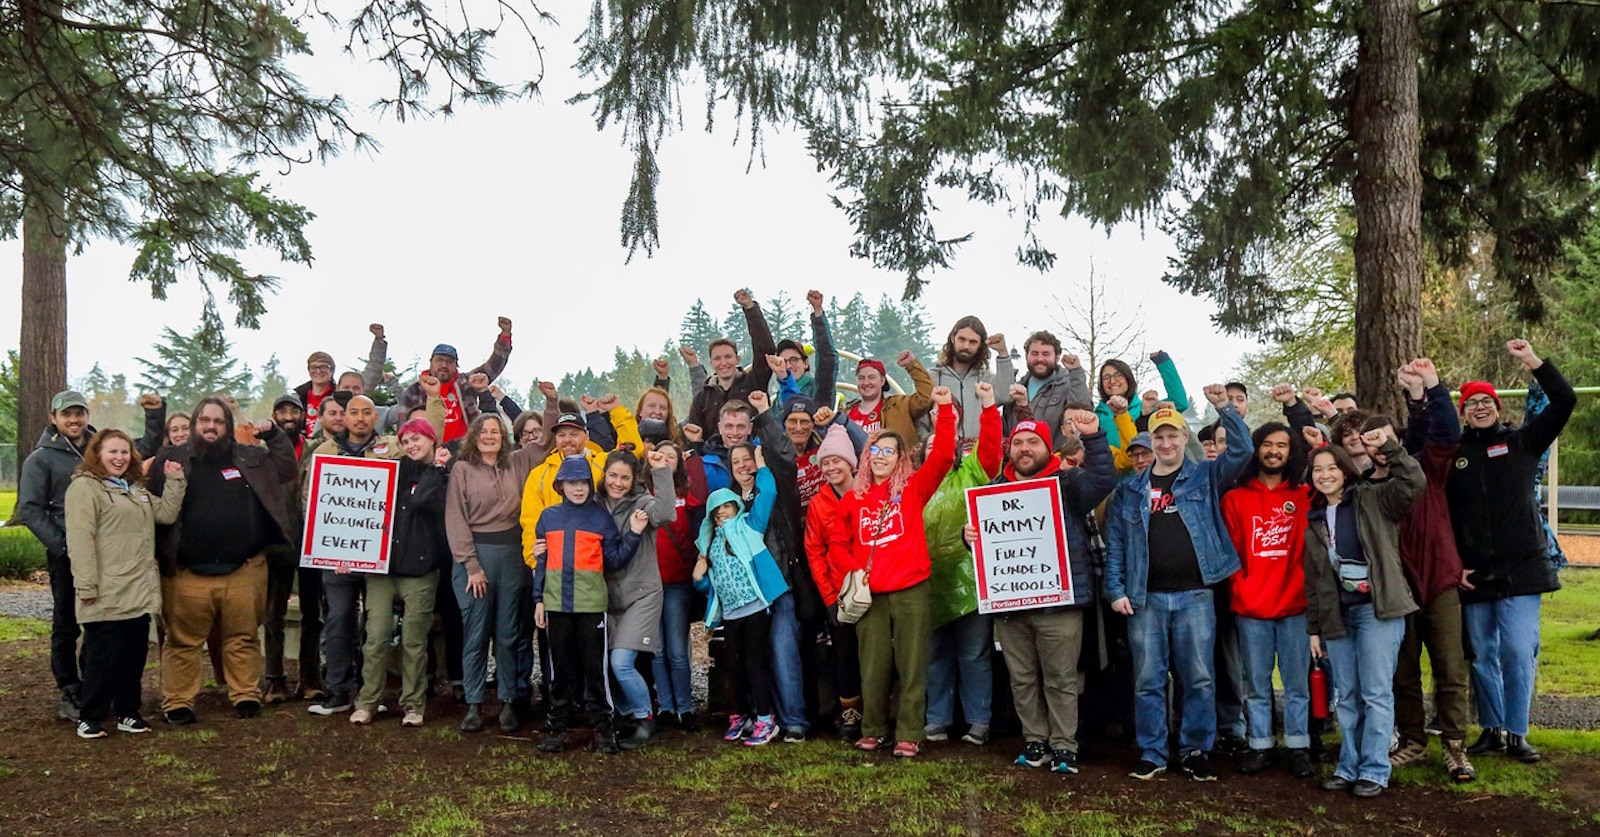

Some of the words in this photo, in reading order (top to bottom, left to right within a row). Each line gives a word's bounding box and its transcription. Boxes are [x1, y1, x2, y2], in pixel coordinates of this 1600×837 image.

[324, 472, 380, 493] TAMMY
[320, 493, 391, 515] CARPENTER
[1002, 499, 1024, 511] DR.
[981, 515, 1046, 534] TAMMY
[321, 536, 372, 552] EVENT
[1261, 533, 1288, 547] DSA
[995, 546, 1037, 561] FULLY
[993, 563, 1052, 576] FUNDED
[989, 574, 1061, 594] SCHOOLS!
[992, 600, 1021, 609] Portland
[1021, 597, 1038, 605] DSA
